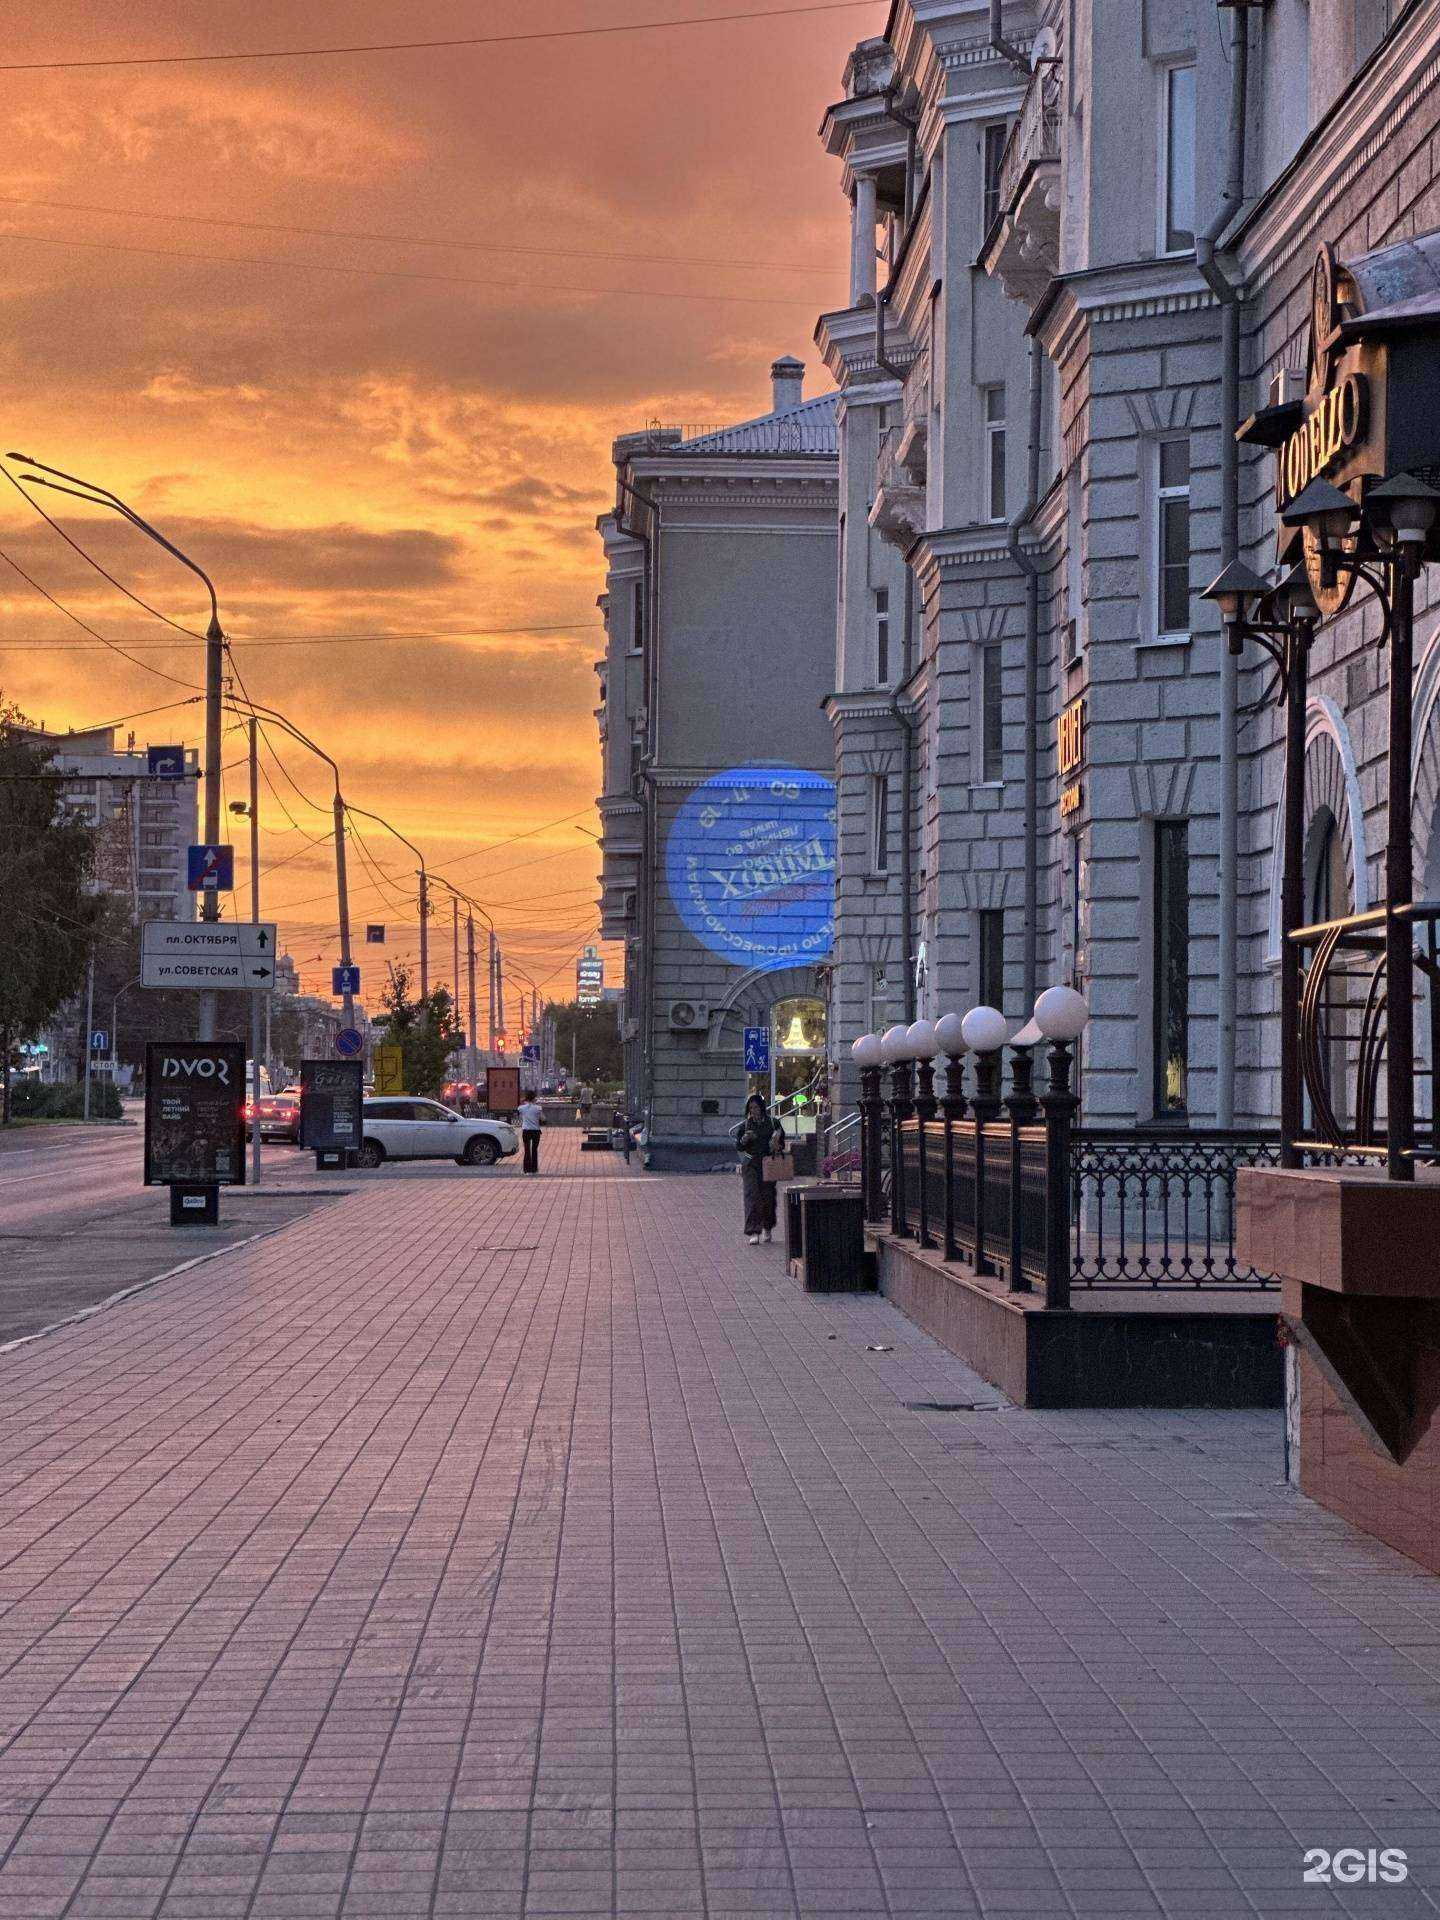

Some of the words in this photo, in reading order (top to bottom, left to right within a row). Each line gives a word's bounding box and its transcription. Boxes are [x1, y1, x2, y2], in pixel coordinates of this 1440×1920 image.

[1280, 373, 1361, 505] ODELLO
[166, 935, 237, 945] пл.ОКТЯБРЯ
[159, 966, 238, 976] ул.СОВЕТСКАЯ
[161, 1057, 230, 1086] DVOR
